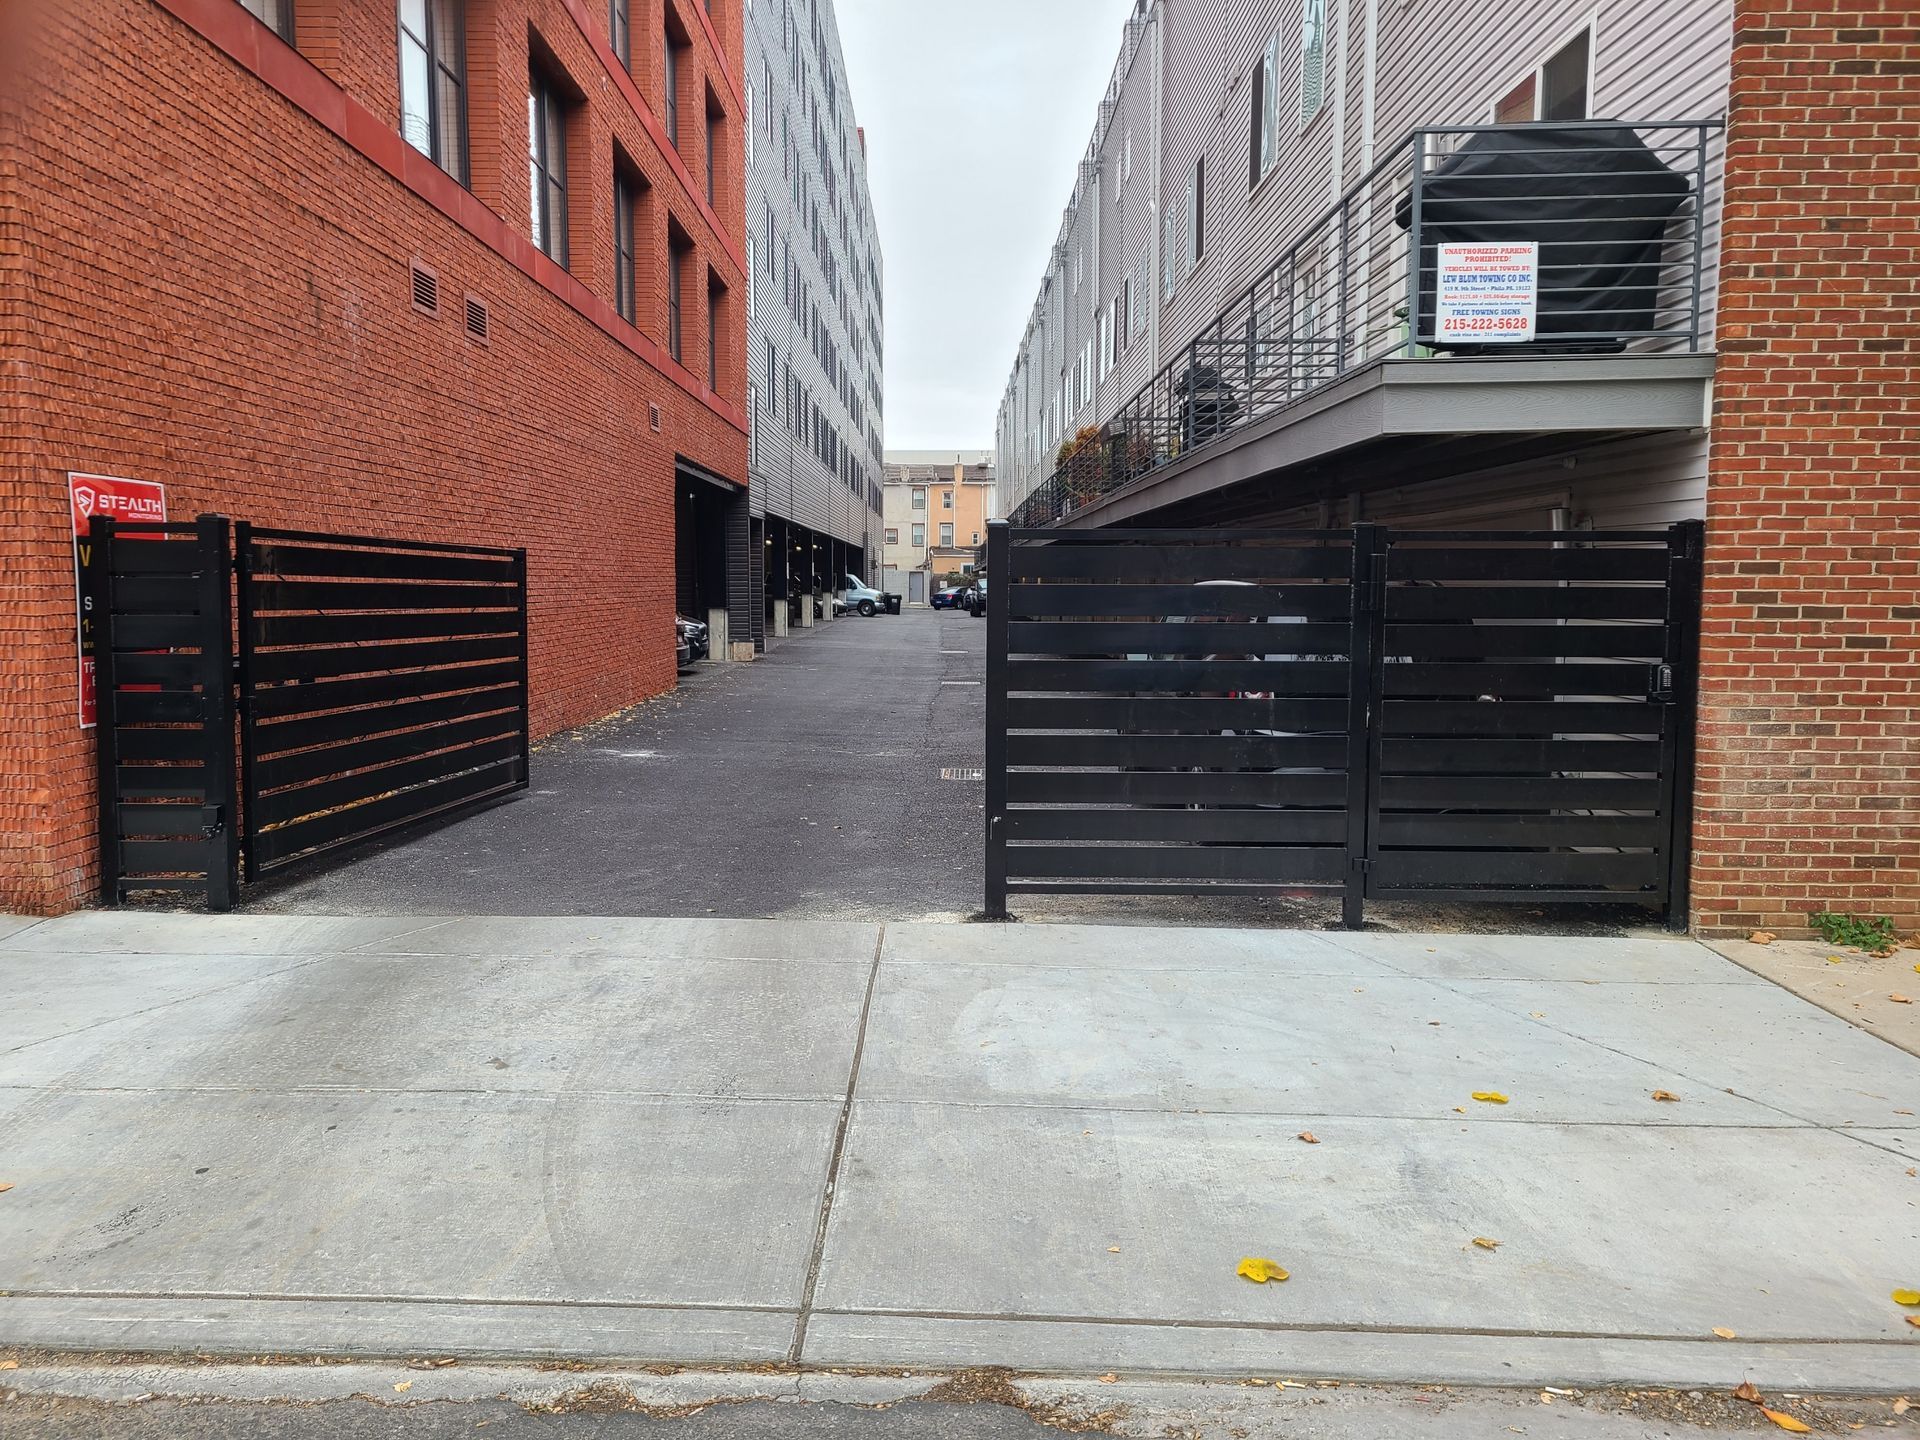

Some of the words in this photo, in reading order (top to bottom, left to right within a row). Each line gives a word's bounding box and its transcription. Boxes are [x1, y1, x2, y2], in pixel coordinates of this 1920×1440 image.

[1443, 275, 1457, 283] LEW
[1459, 275, 1478, 283] BLUM
[1444, 318, 1528, 330] 215-222-5628
[99, 494, 163, 513] STEALTH
